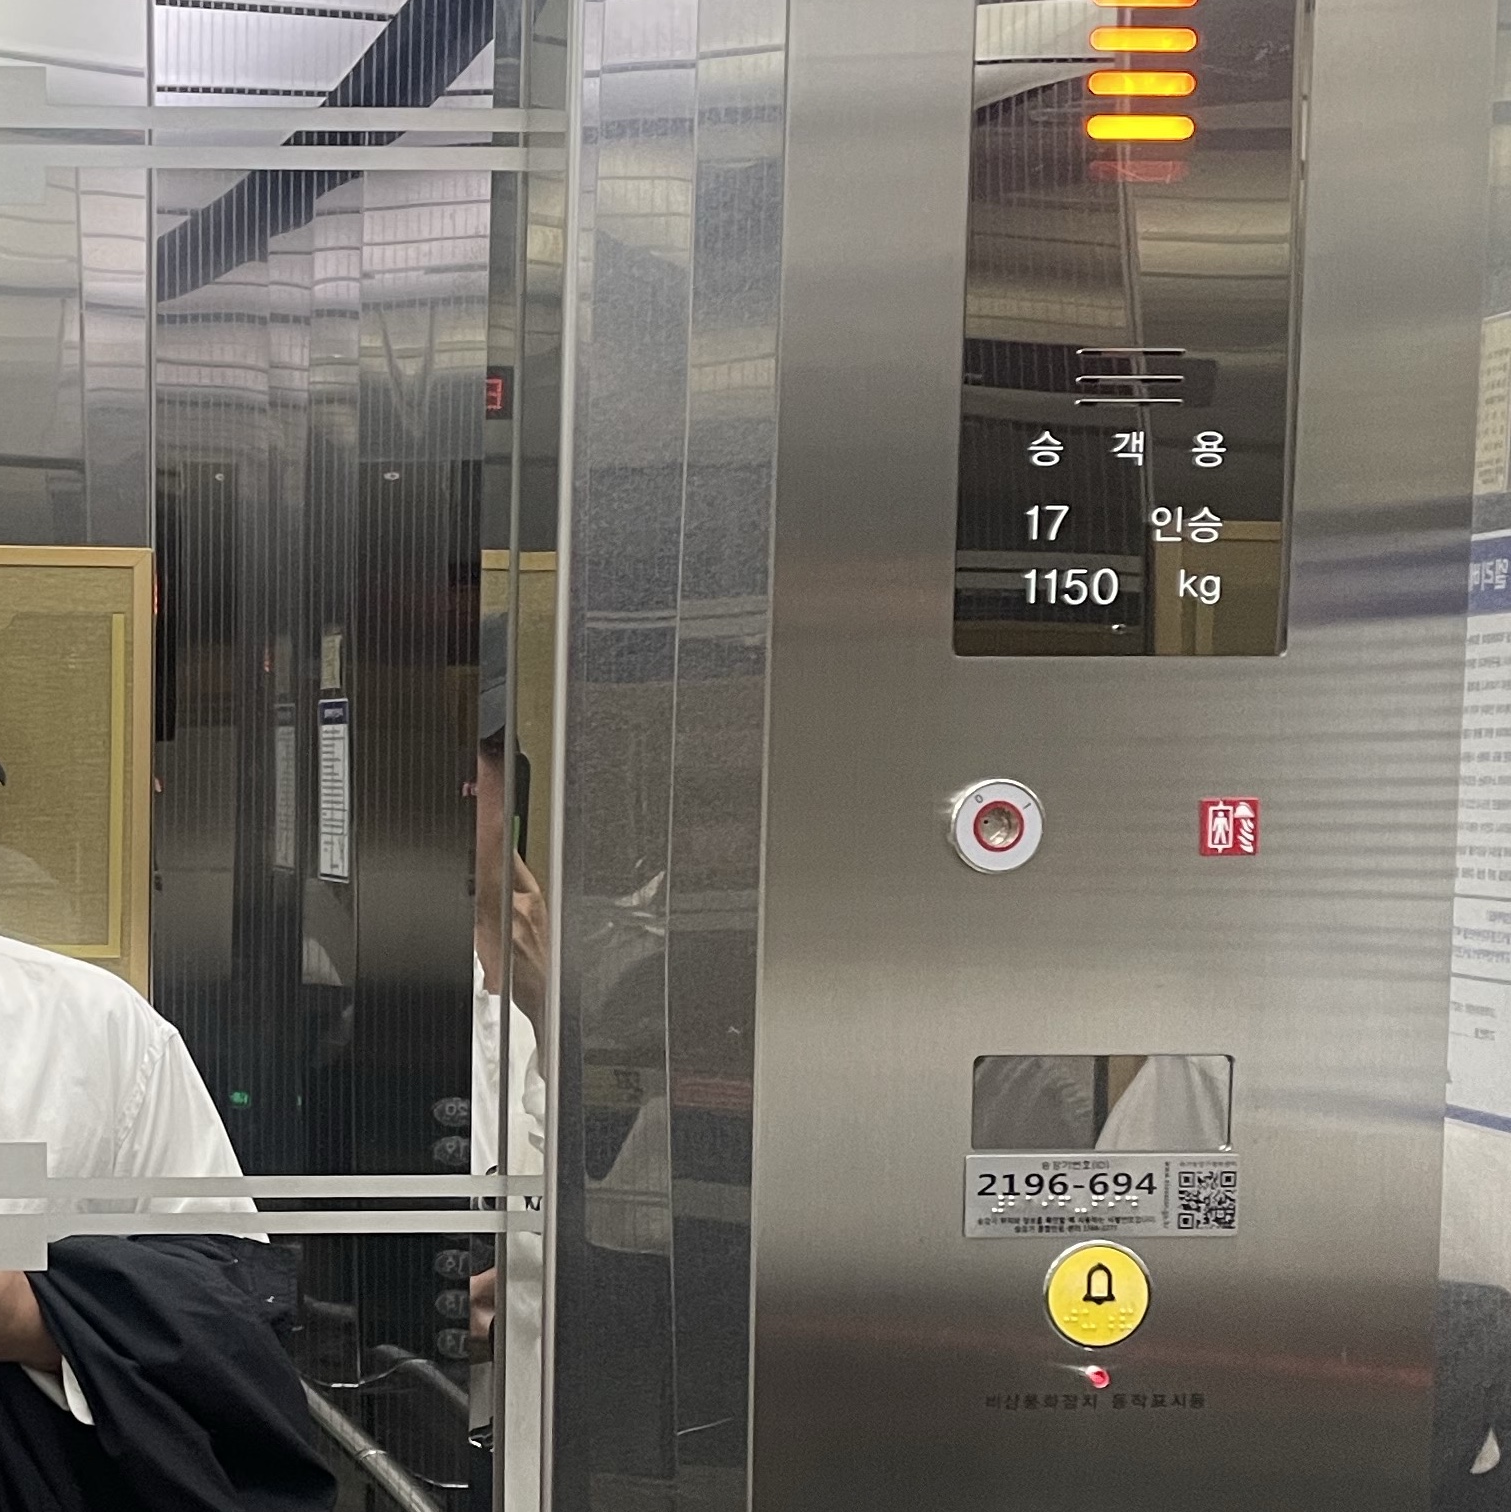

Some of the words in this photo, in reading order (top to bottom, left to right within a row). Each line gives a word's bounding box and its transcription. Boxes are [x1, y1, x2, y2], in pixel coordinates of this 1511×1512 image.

[1025, 504, 1069, 541] 17
[1151, 505, 1223, 543] 인승
[1023, 568, 1119, 605] 1150
[1178, 570, 1221, 604] kg
[977, 1172, 1158, 1196] 2196-694
